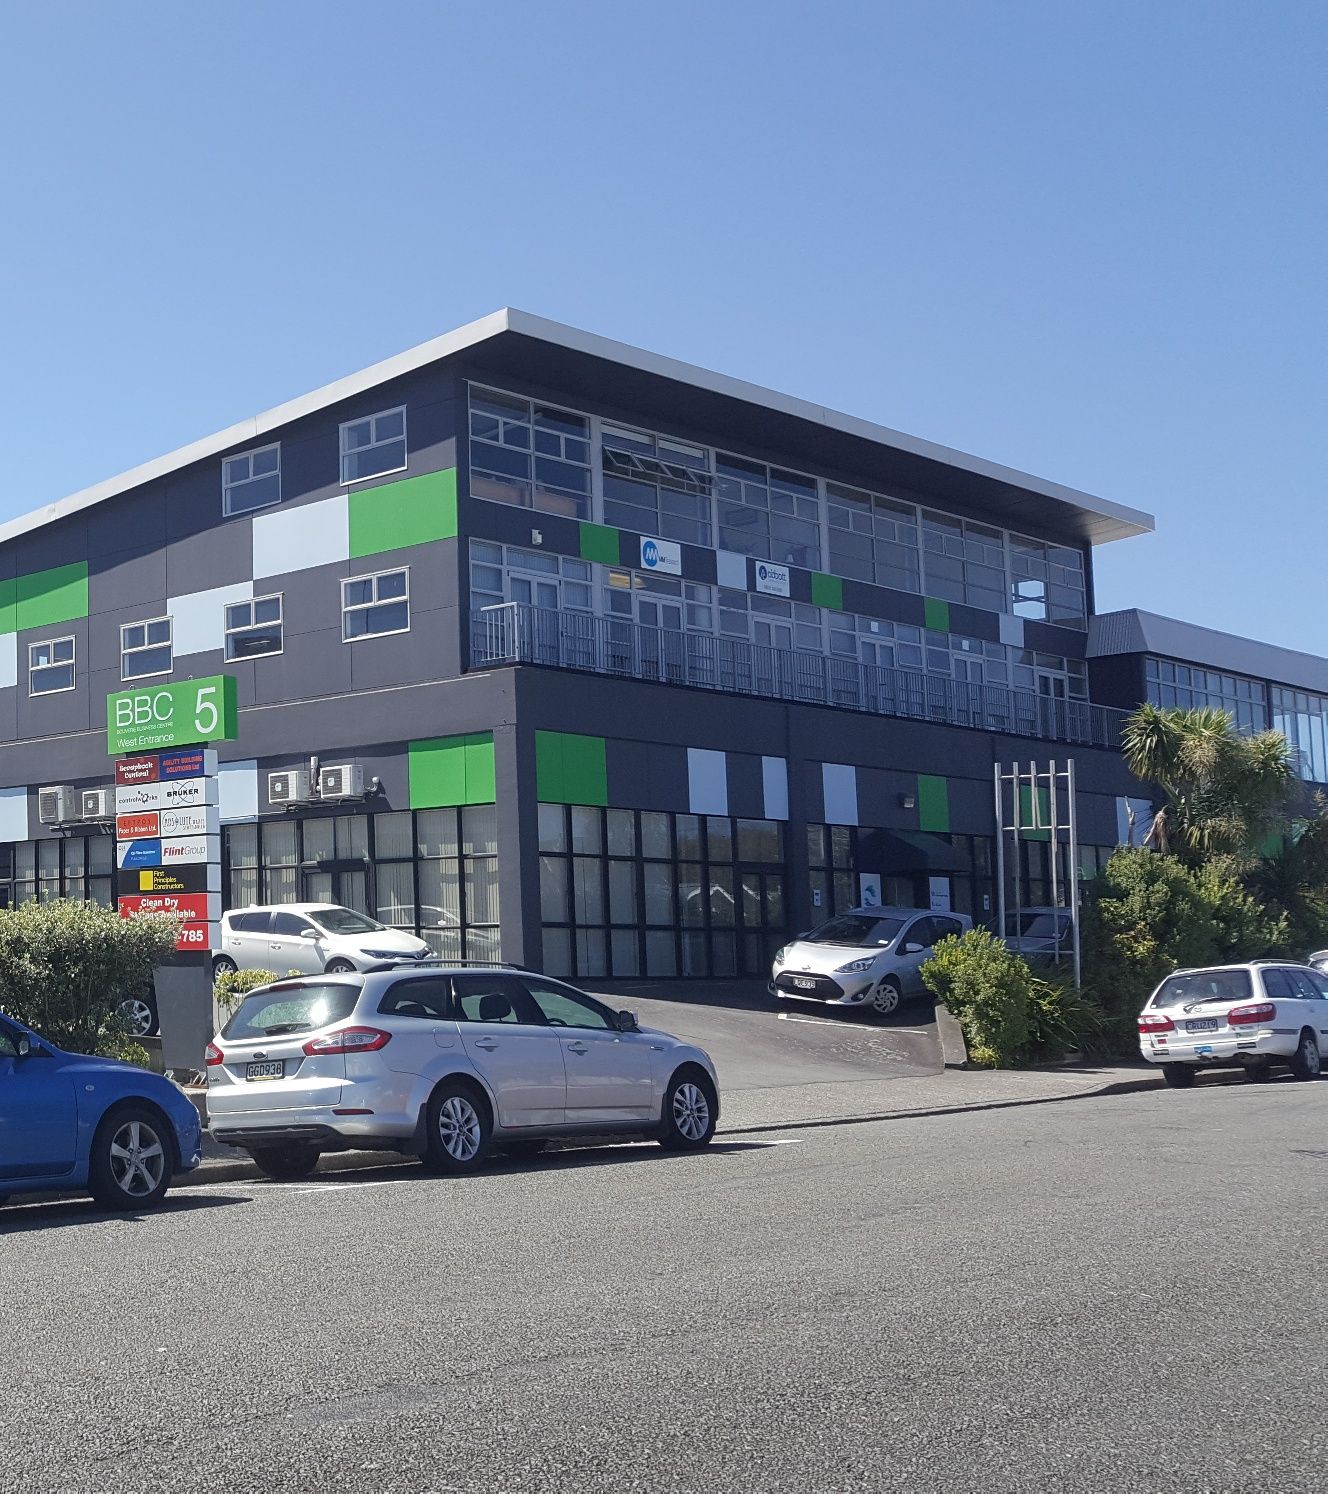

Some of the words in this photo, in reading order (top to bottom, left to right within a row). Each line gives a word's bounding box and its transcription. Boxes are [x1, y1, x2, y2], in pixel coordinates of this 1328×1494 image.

[116, 691, 174, 727] BBC
[194, 686, 218, 734] 5
[116, 737, 138, 748] West
[139, 733, 175, 745] Entrance
[166, 788, 199, 798] BRUKER
[141, 899, 163, 907] Clean
[164, 898, 179, 909] Dry
[248, 1063, 282, 1077] GGD938
